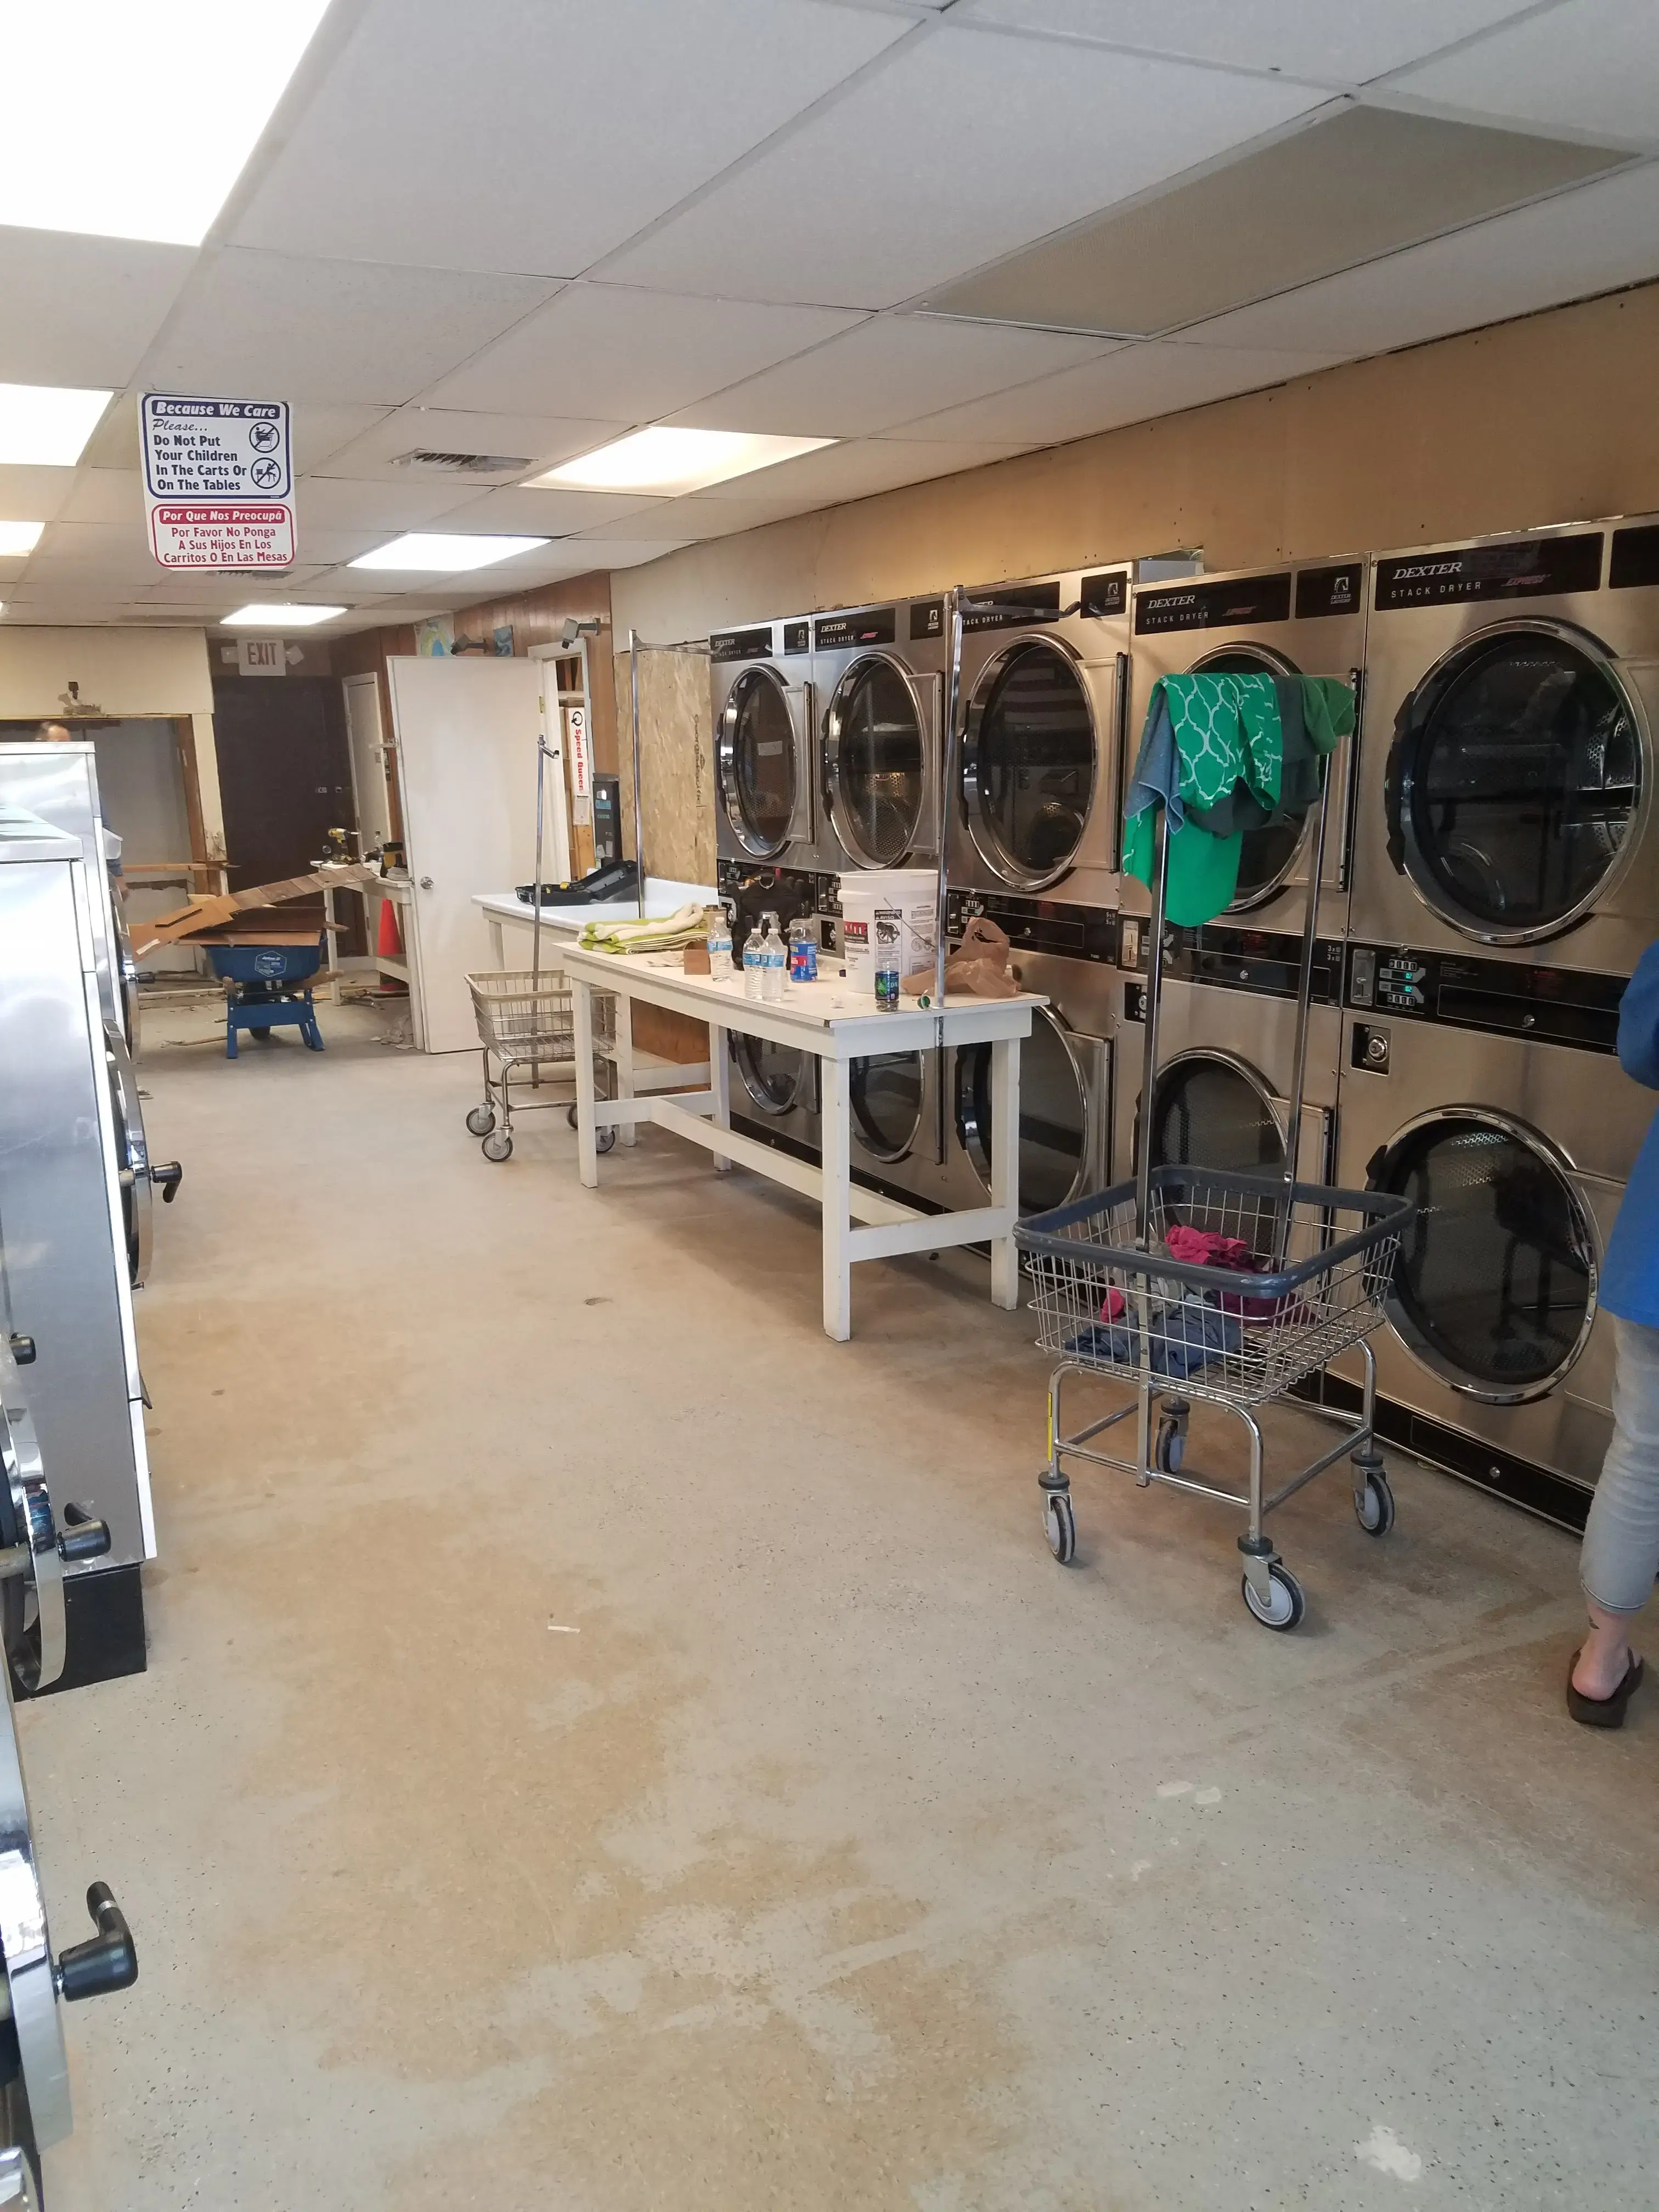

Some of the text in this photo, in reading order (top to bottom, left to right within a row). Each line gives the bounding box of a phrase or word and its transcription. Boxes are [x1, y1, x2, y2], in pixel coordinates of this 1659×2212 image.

[156, 402, 276, 417] Because We Care
[152, 419, 207, 431] Please...
[154, 435, 221, 447] Do Not Put
[155, 450, 238, 461] Your Children
[156, 465, 247, 476] In The Carts Or
[157, 480, 240, 490] On The Tables
[163, 511, 183, 521] Por
[186, 511, 207, 521] Que
[210, 511, 229, 521] Nos
[171, 527, 276, 539] Por Favor No Ponga
[178, 540, 272, 551] A Sus Hijos En Los
[164, 552, 287, 563] Carritos O En Las Mesas
[1392, 562, 1462, 580] DEXTER
[1391, 582, 1481, 599] STACK DRYER
[1147, 595, 1196, 609] DEXTER
[982, 614, 1003, 623] DRYER
[1146, 612, 1209, 625] STACK DRYER
[821, 623, 847, 633] DEXTER
[247, 642, 276, 665] EXIT
[574, 729, 583, 758] Speed
